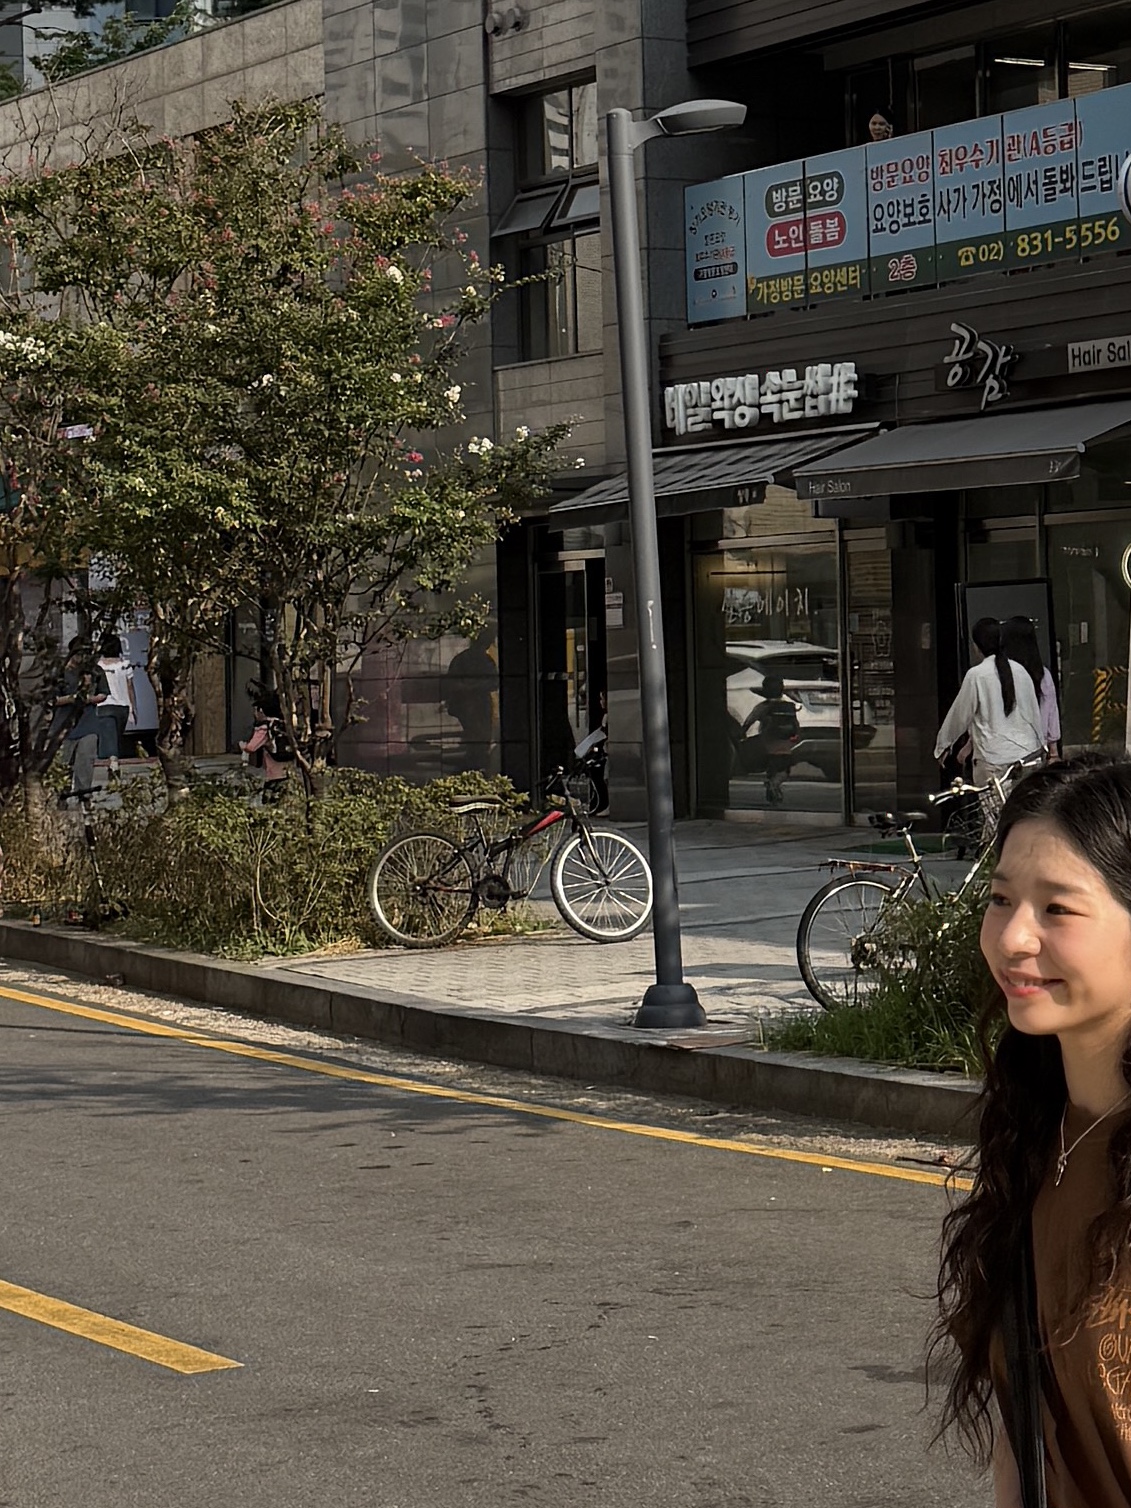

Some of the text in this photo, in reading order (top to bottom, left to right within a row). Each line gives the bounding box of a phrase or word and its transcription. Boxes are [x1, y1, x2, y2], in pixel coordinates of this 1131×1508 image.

[871, 155, 931, 192] 방문요양
[1016, 217, 1120, 257] 831-5556
[1071, 345, 1102, 367] Hair
[809, 480, 851, 494] Hair Salon
